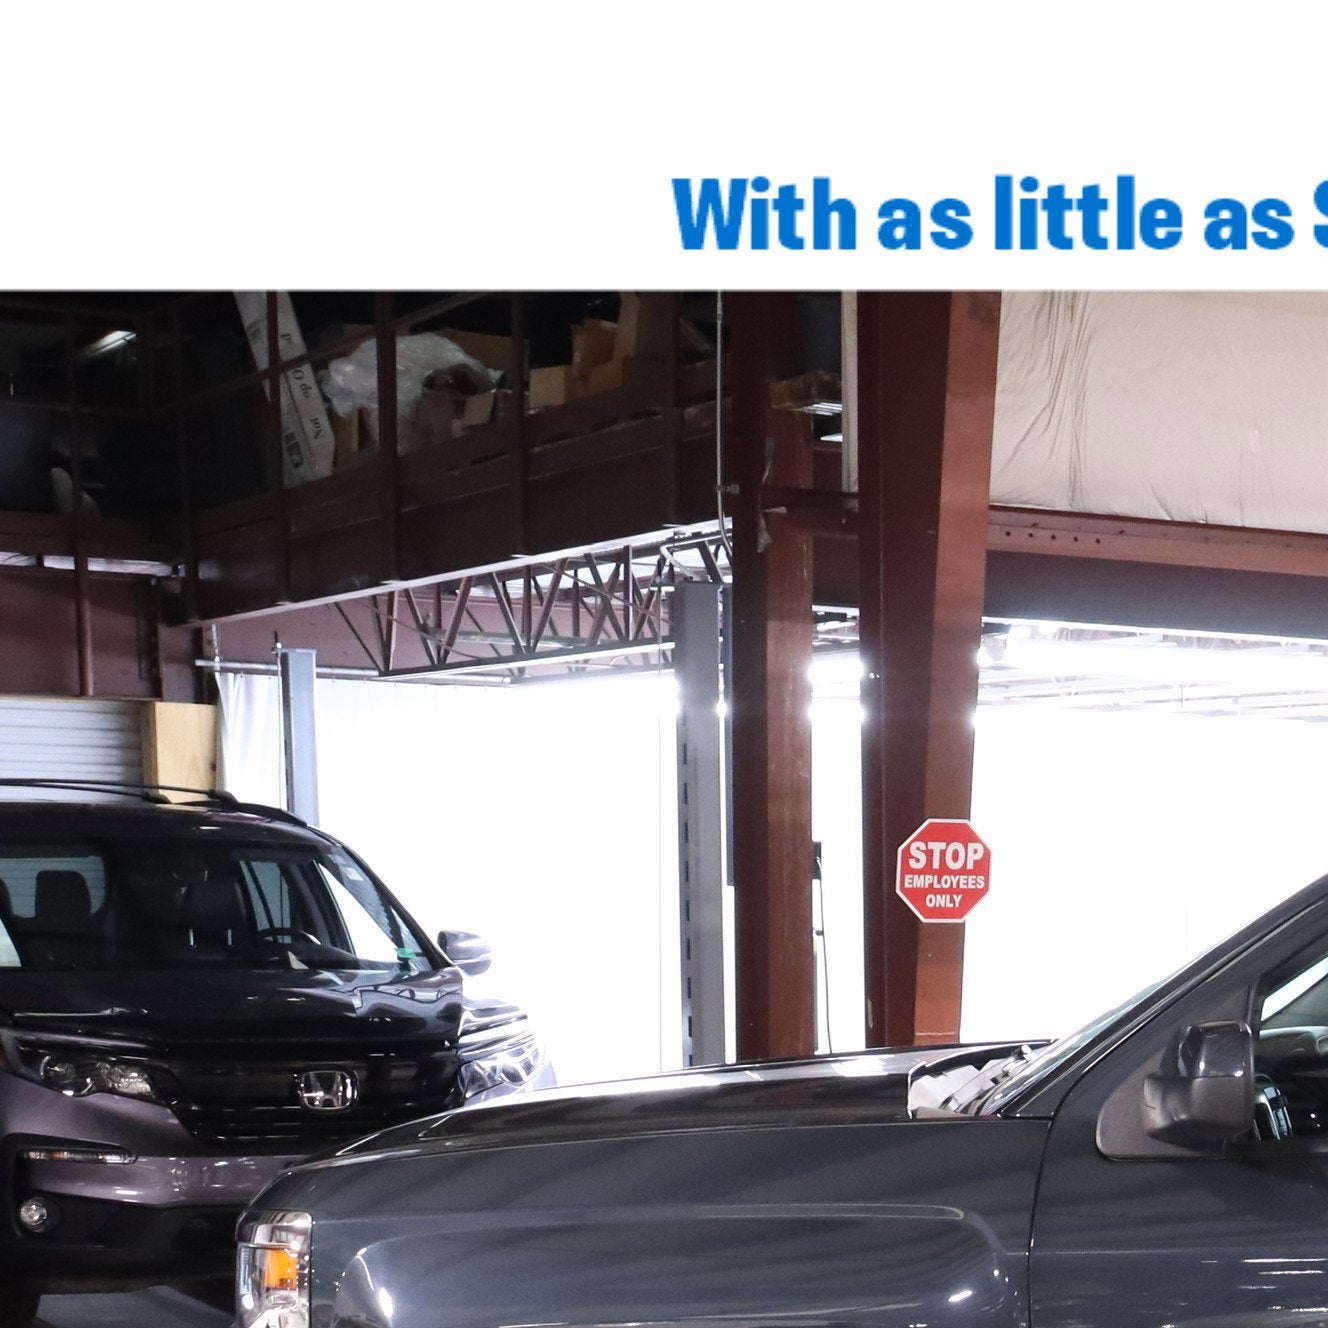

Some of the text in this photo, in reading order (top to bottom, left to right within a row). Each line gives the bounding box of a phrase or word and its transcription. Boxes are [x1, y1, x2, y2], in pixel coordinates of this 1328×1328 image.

[908, 841, 984, 870] STOP
[904, 875, 985, 889] EMPLOYEES
[926, 894, 962, 908] ONLY
